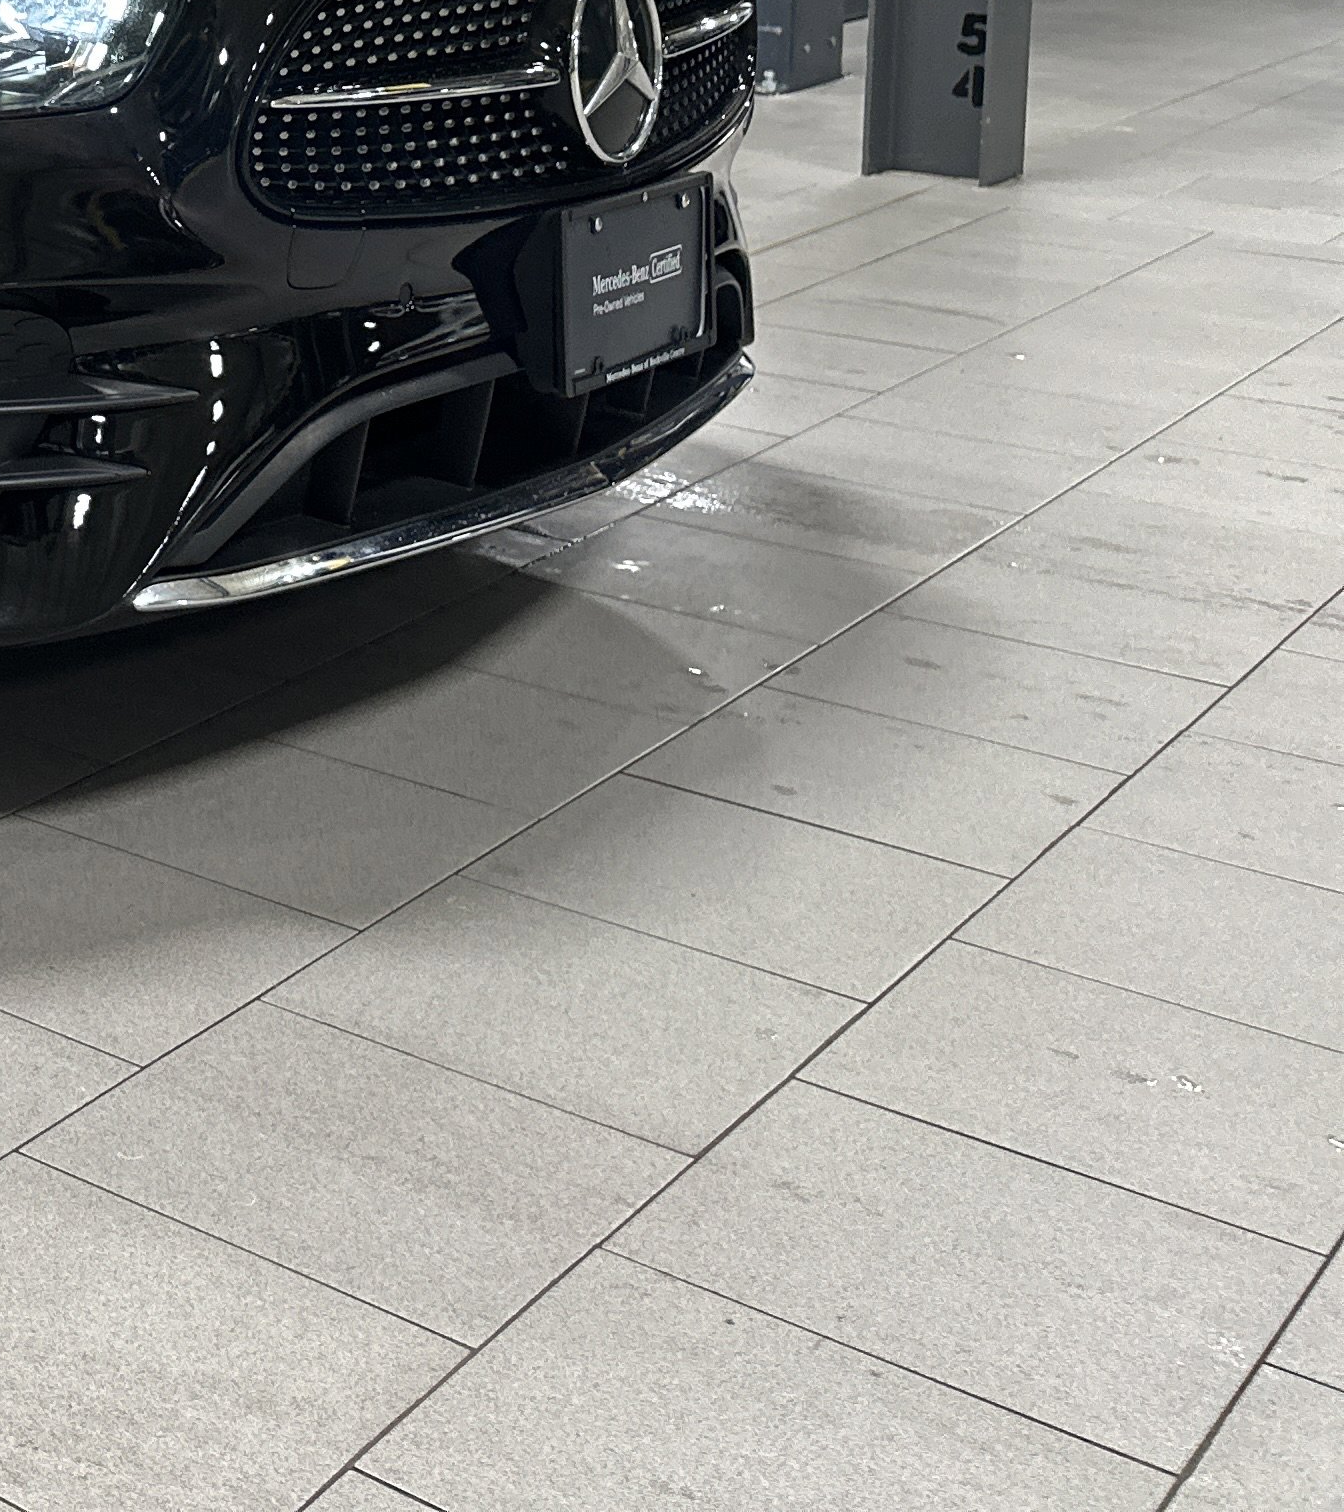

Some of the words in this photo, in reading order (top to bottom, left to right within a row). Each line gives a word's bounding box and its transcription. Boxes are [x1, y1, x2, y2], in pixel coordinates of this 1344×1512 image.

[592, 264, 649, 296] Mercedes-Benz
[651, 250, 681, 277] Certified
[593, 297, 623, 316] Pre-Owned
[624, 291, 645, 307] Vehicles
